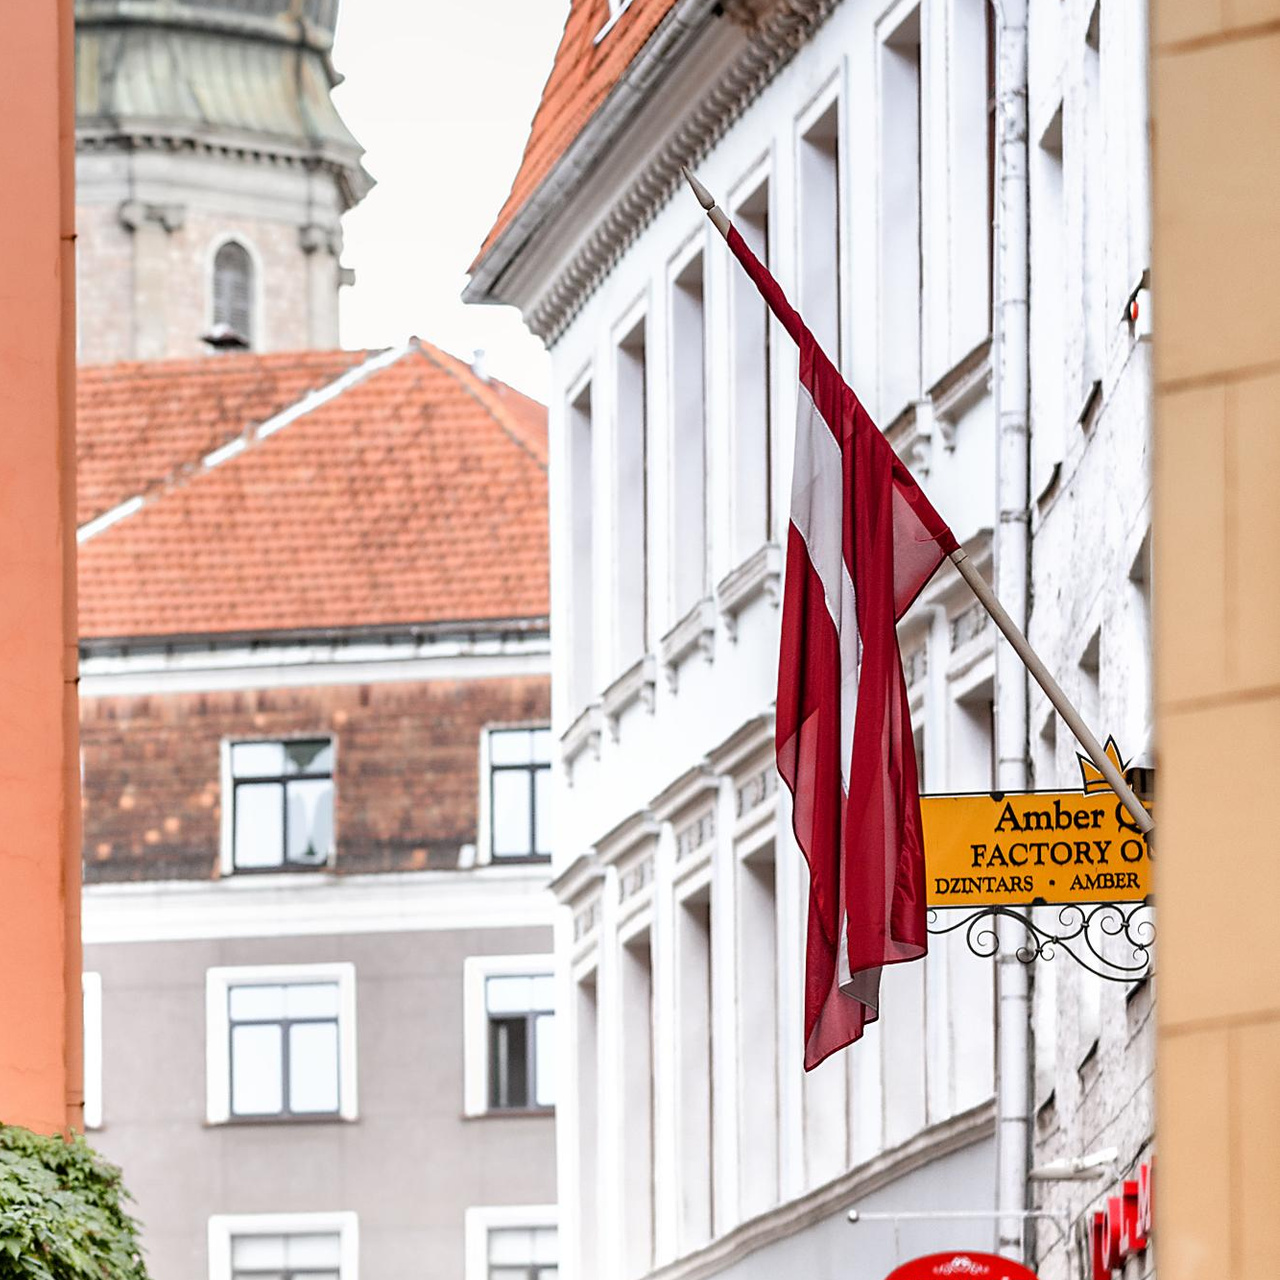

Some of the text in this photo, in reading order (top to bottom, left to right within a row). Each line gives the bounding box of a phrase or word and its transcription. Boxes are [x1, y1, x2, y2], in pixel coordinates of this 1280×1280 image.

[994, 799, 1105, 832] Amber
[971, 841, 1111, 867] FACTORY
[935, 872, 1141, 895] DZINTARS AMBER
